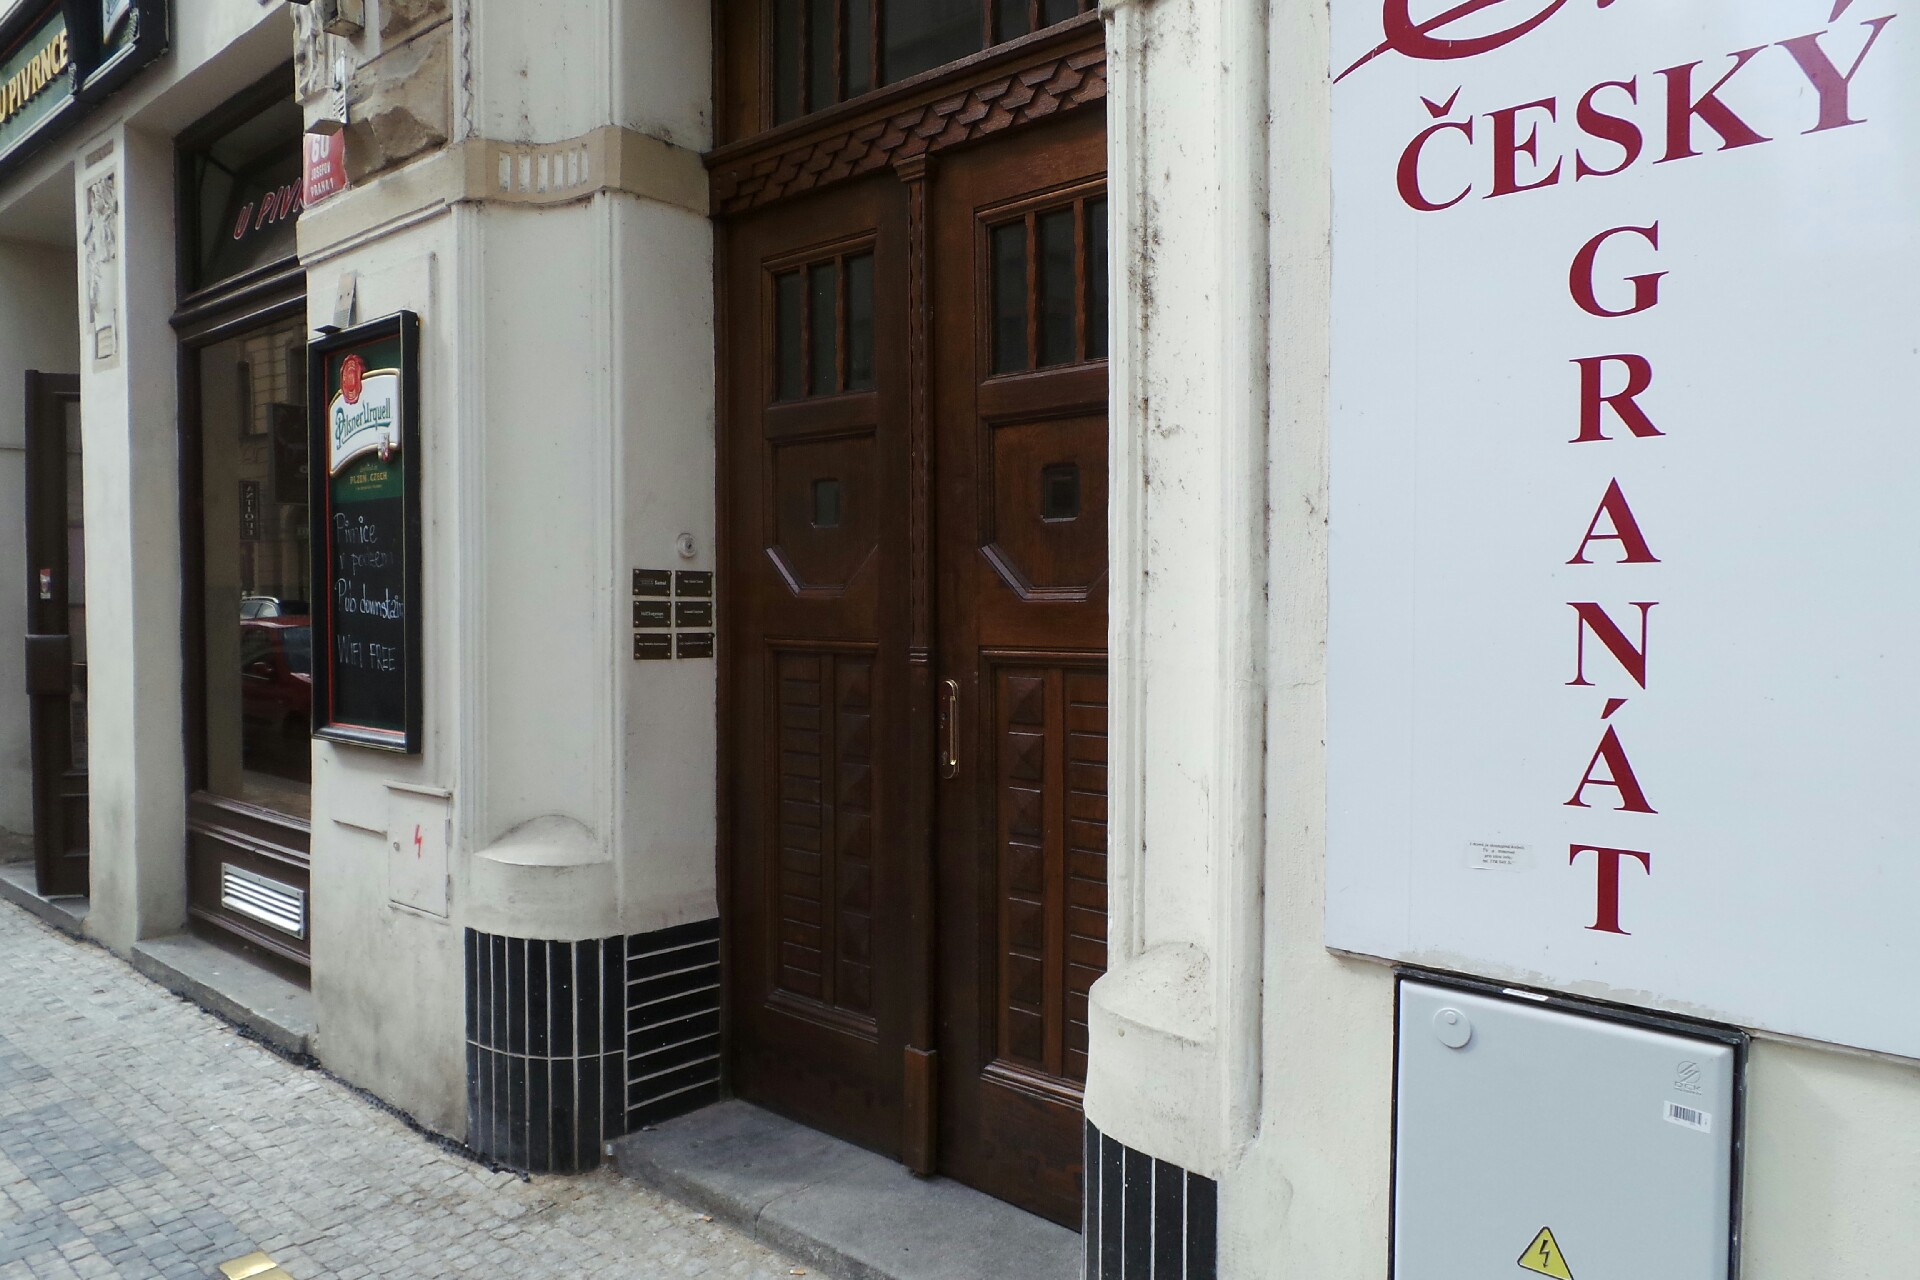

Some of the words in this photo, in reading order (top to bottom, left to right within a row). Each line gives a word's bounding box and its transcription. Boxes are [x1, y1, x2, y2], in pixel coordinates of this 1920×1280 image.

[8, 27, 69, 114] PIVRNCE
[1397, 0, 1897, 212] ČESKÝ
[310, 179, 330, 198] PRAHA
[329, 177, 334, 189] 1
[311, 161, 331, 180] JOSEFOV
[234, 202, 254, 240] U
[335, 407, 363, 450] Pilsner
[362, 398, 391, 430] Urquell
[335, 578, 357, 613] Pub
[1563, 220, 1669, 935] GRANÁT
[369, 643, 396, 672] FREE
